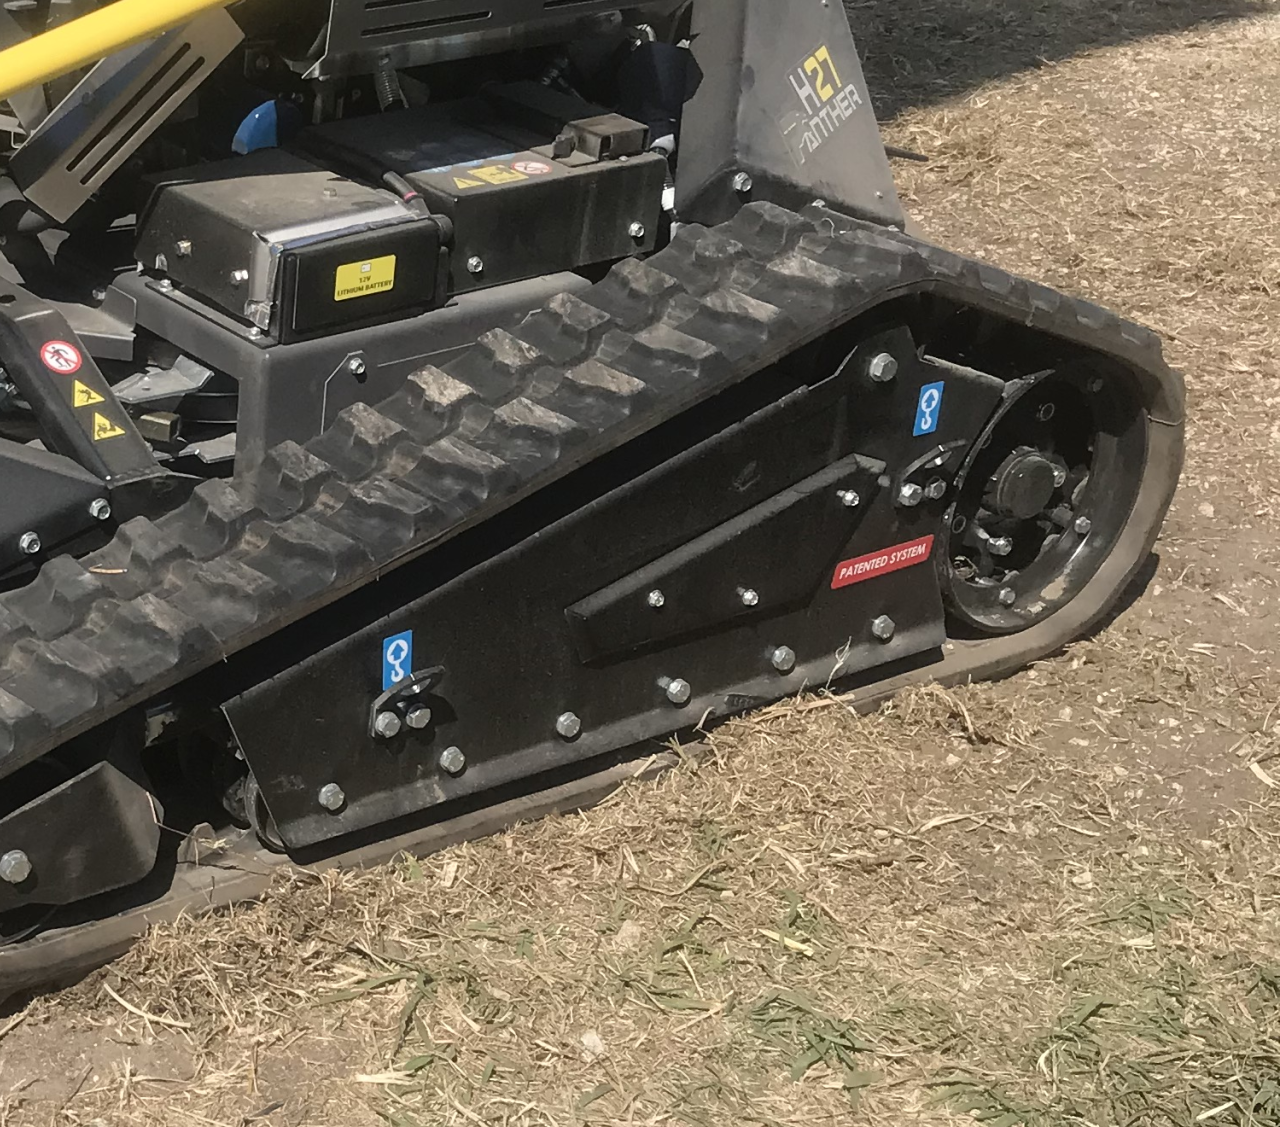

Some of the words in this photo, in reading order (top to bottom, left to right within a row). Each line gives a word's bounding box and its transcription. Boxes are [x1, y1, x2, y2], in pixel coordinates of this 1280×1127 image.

[788, 44, 843, 116] H27
[337, 285, 364, 297] LITHIUM
[365, 279, 393, 291] BATTERY
[839, 555, 888, 580] PATENTED
[889, 543, 927, 564] SYSTEM
